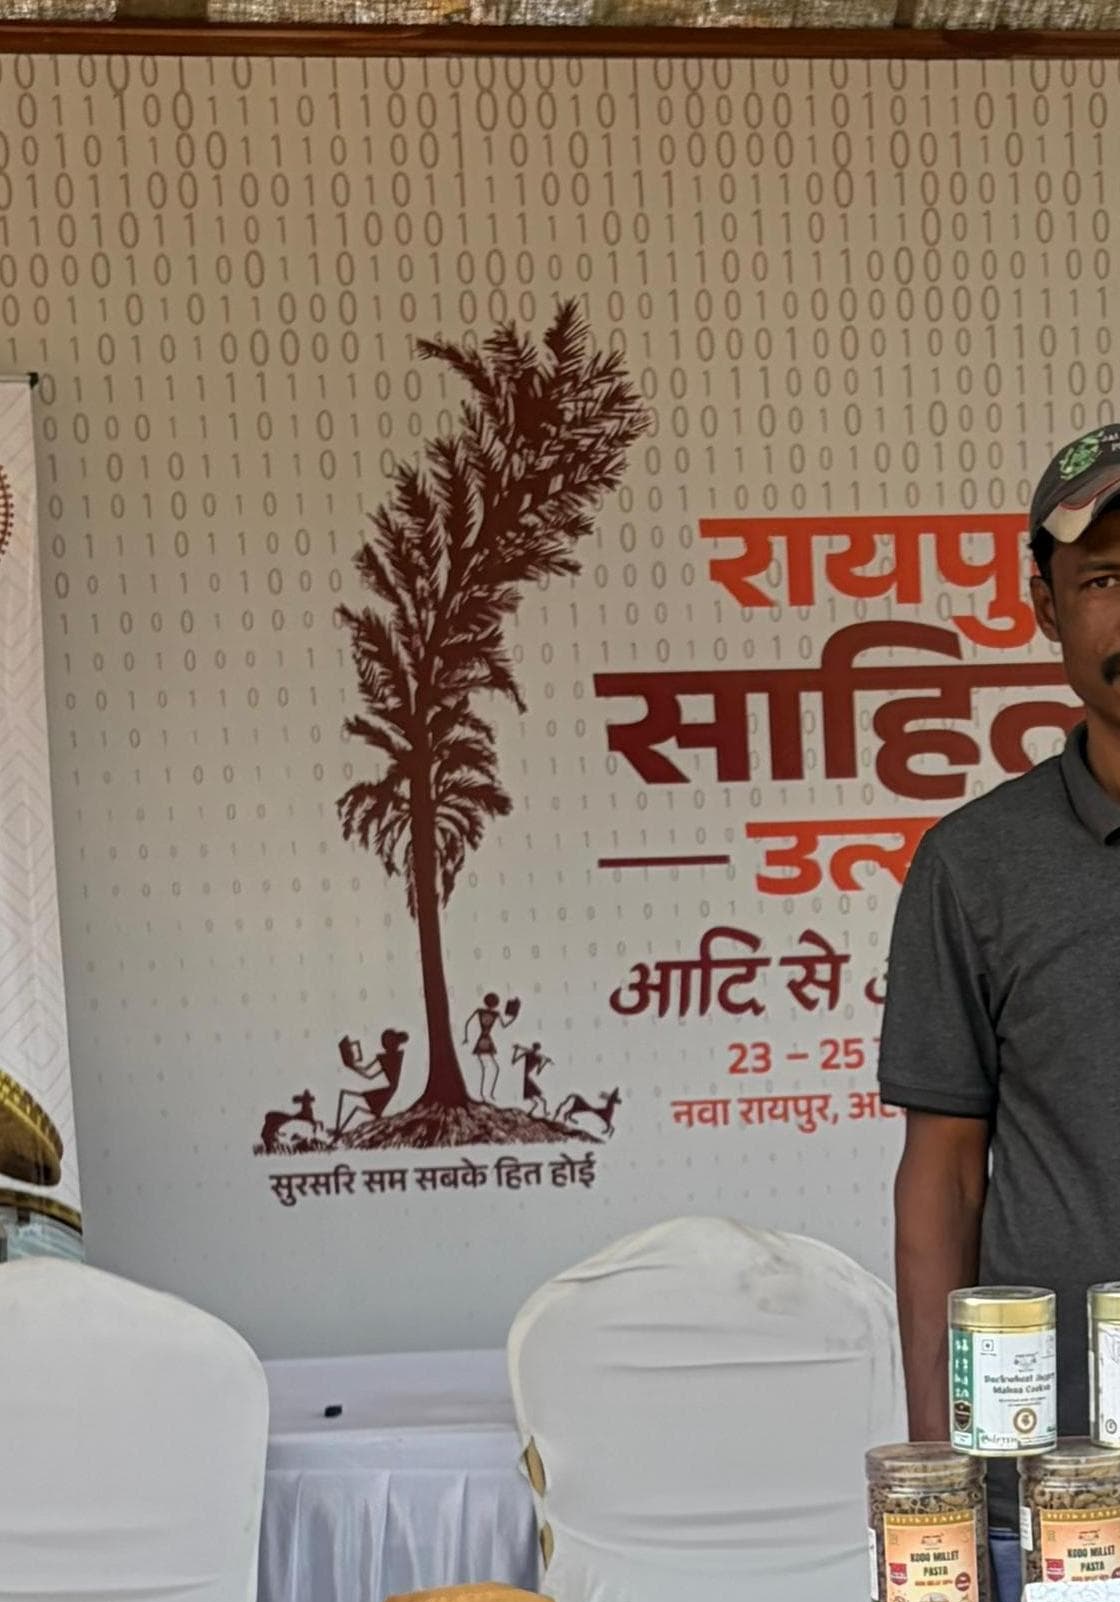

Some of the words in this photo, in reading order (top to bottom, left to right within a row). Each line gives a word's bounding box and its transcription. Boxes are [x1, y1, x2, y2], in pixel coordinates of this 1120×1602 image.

[698, 513, 1037, 649] रायपु
[608, 926, 771, 1019] आदि
[778, 929, 851, 1012] से
[728, 1041, 772, 1074] 23
[819, 1037, 865, 1070] 25
[671, 1098, 730, 1129] नवा
[737, 1092, 840, 1133] रायपुर,
[269, 1163, 356, 1208] सुरसरि
[362, 1168, 409, 1195] सम
[414, 1156, 489, 1191] सबके
[493, 1155, 543, 1189] हित
[549, 1152, 597, 1187] होई
[923, 1566, 948, 1577] PASTA
[1080, 1561, 1105, 1572] PASTA
